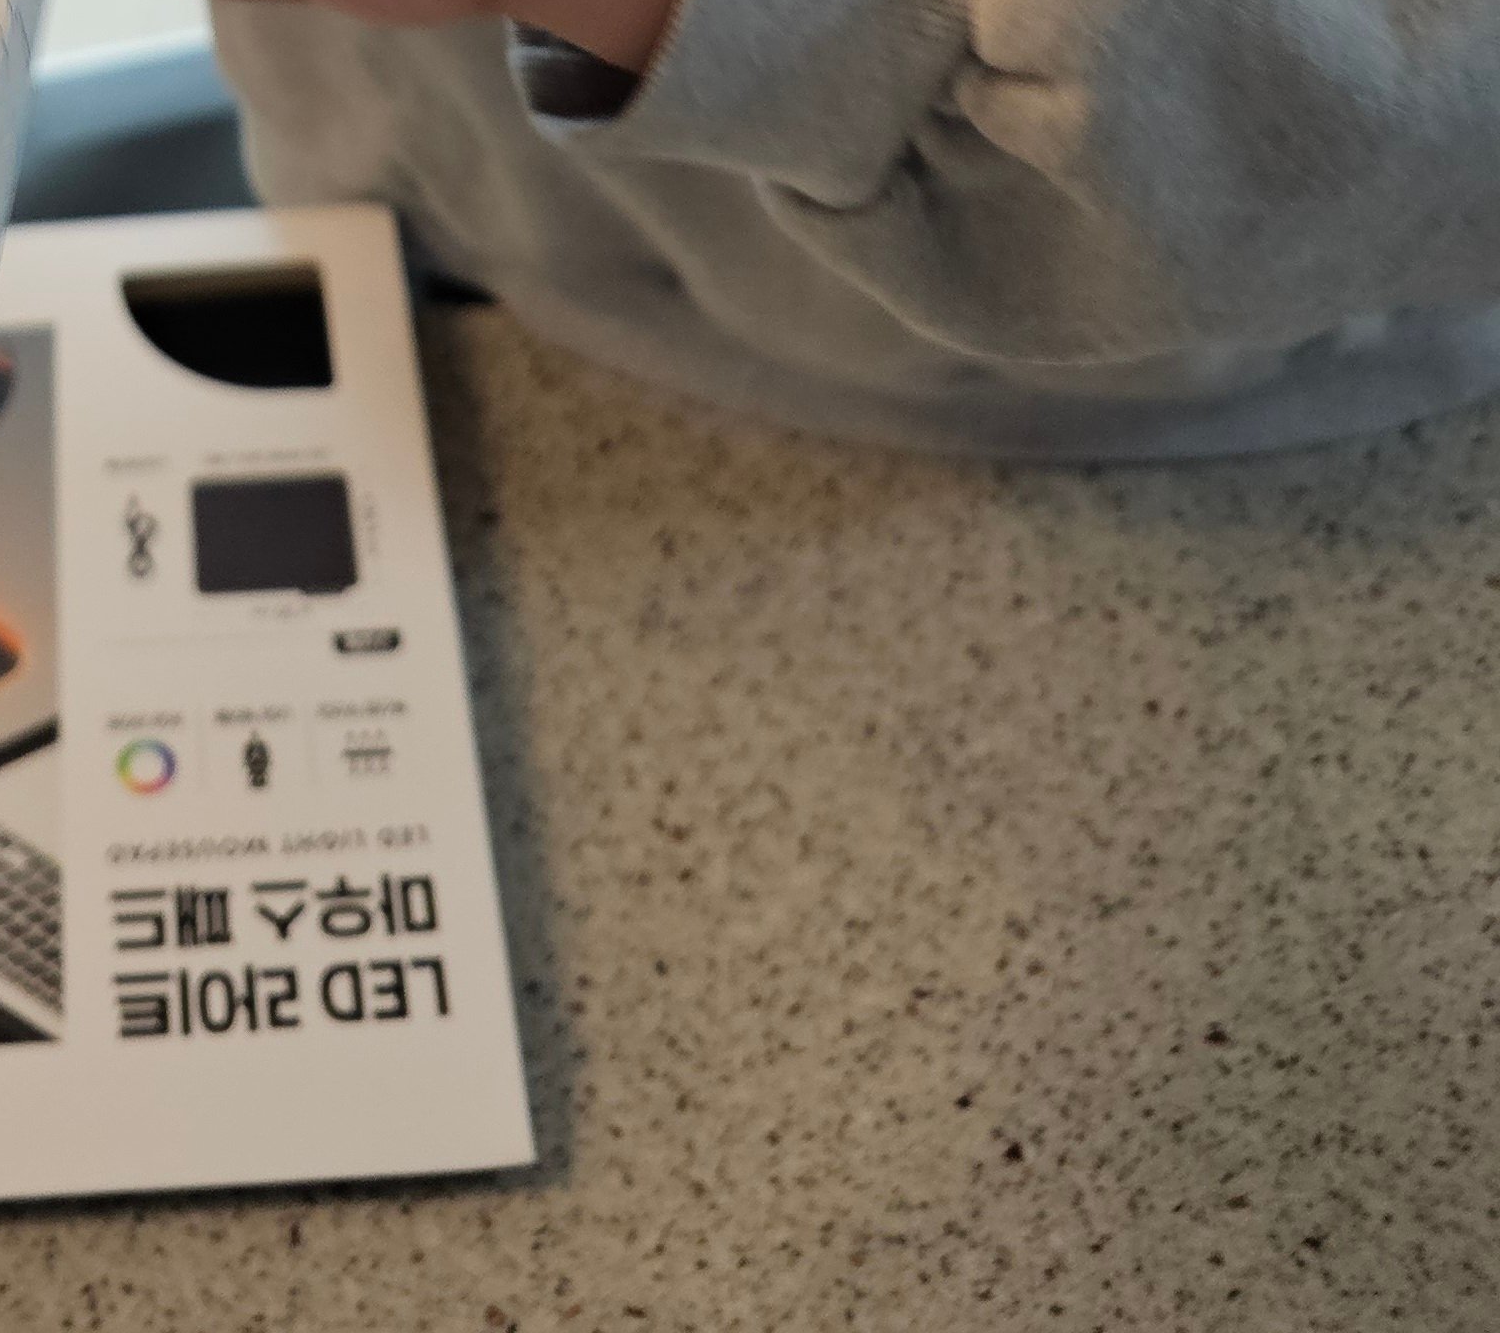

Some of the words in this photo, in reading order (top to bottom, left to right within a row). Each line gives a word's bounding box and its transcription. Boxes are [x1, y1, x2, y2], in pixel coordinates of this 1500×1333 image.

[109, 886, 232, 955] 패드
[252, 874, 439, 941] 마우스
[113, 965, 302, 1043] 라이트
[319, 957, 452, 1025] LED
